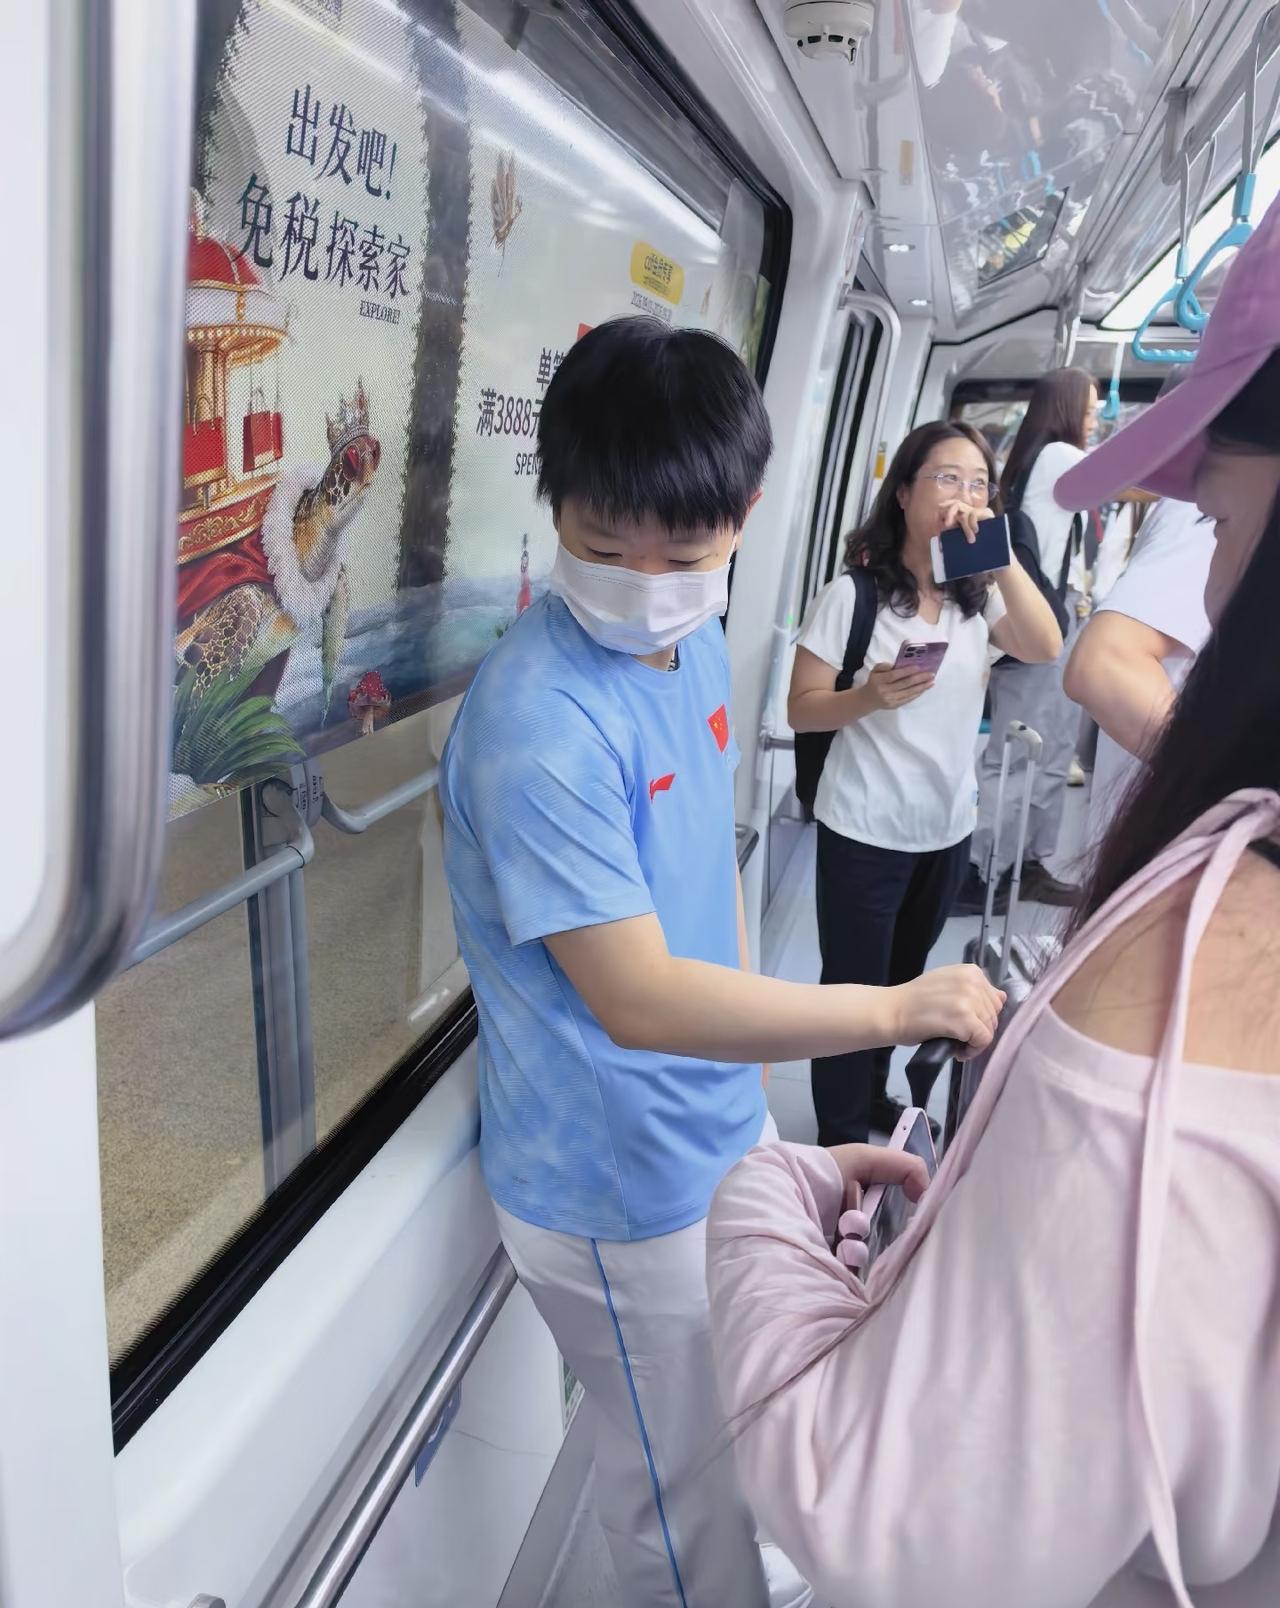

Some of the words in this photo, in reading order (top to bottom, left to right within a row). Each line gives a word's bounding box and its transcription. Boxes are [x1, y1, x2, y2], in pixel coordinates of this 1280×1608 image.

[234, 173, 411, 299] 免税探索家
